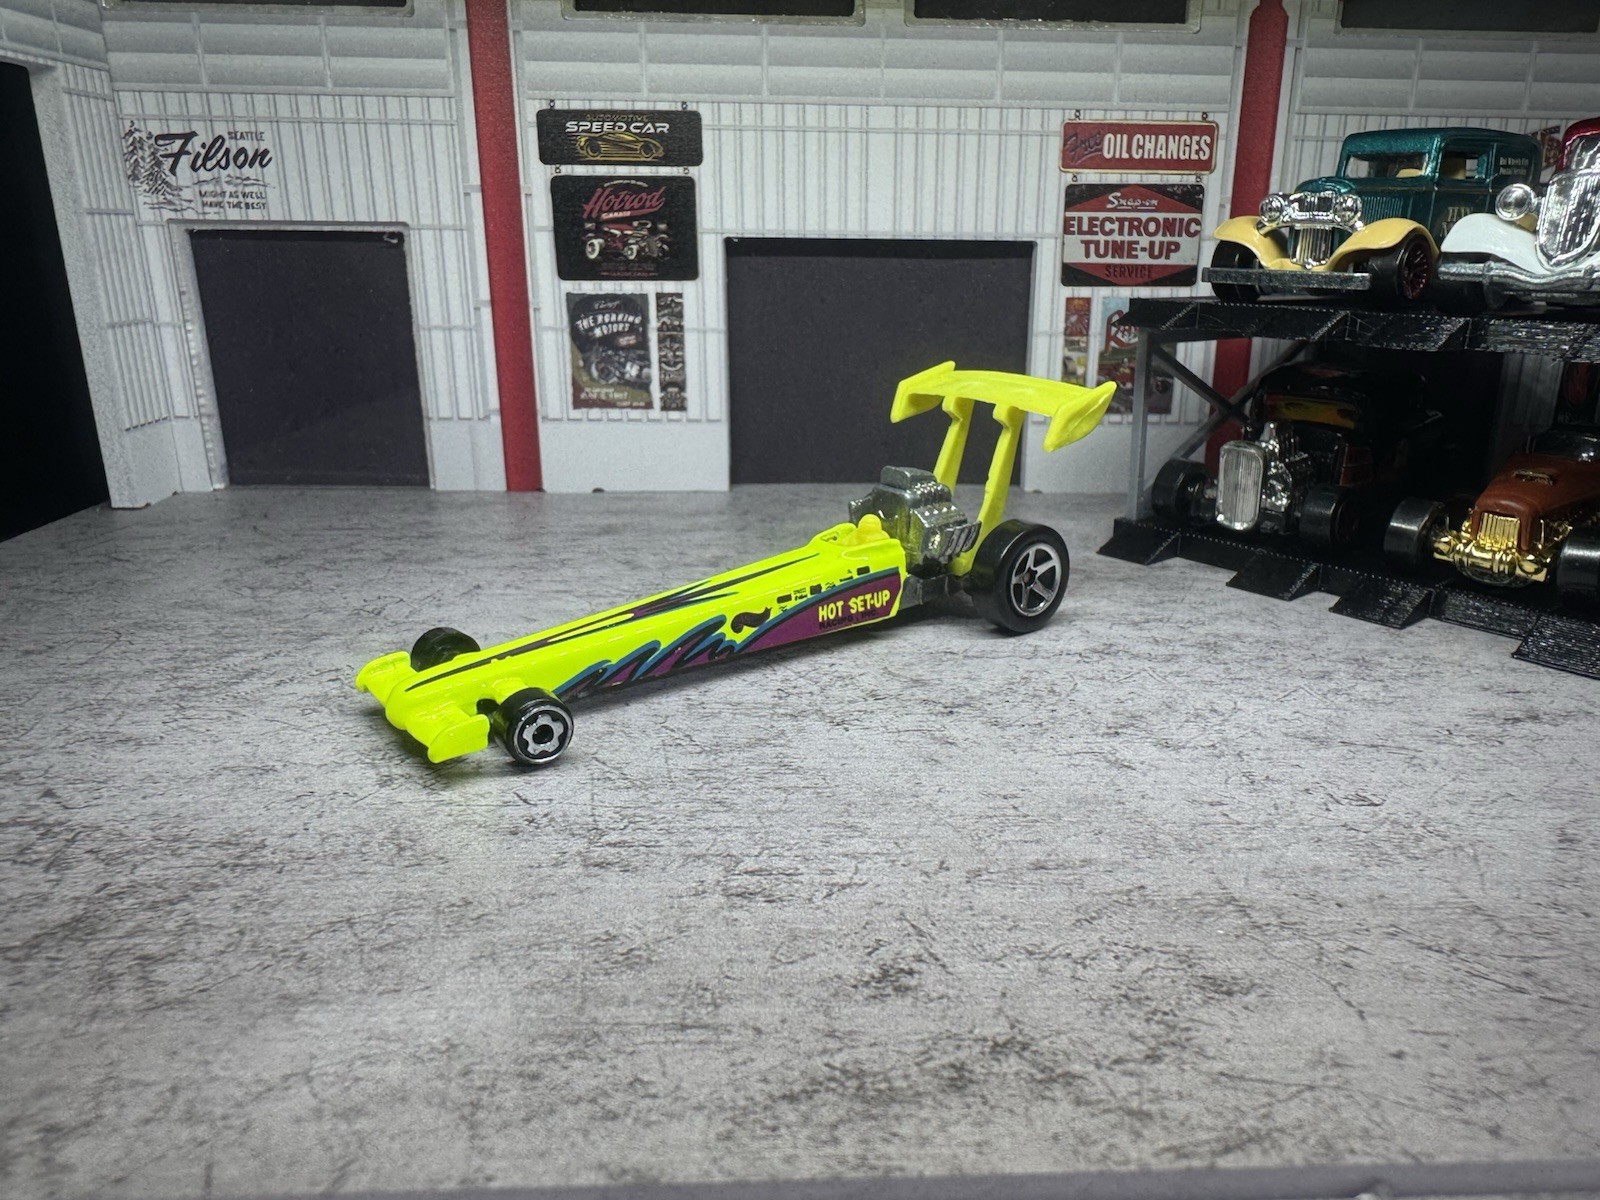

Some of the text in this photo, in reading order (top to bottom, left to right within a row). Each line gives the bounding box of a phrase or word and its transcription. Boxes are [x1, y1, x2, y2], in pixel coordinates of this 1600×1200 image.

[228, 131, 265, 142] SEATTLE
[565, 121, 670, 134] SPEED CAR
[154, 130, 273, 177] Filson
[1103, 133, 1129, 160] OIL
[1131, 133, 1211, 161] CHANGES
[229, 190, 239, 199] AS
[241, 191, 266, 200] WELL
[582, 185, 667, 219] Hotrod
[1106, 192, 1158, 209] Snap-on
[226, 201, 243, 210] THE
[244, 201, 266, 210] BEST
[1063, 216, 1202, 238] ELECTRONIC
[1080, 239, 1181, 260] TUNE-UP
[575, 314, 595, 331] THE
[818, 589, 891, 623] HOT SET-UP
